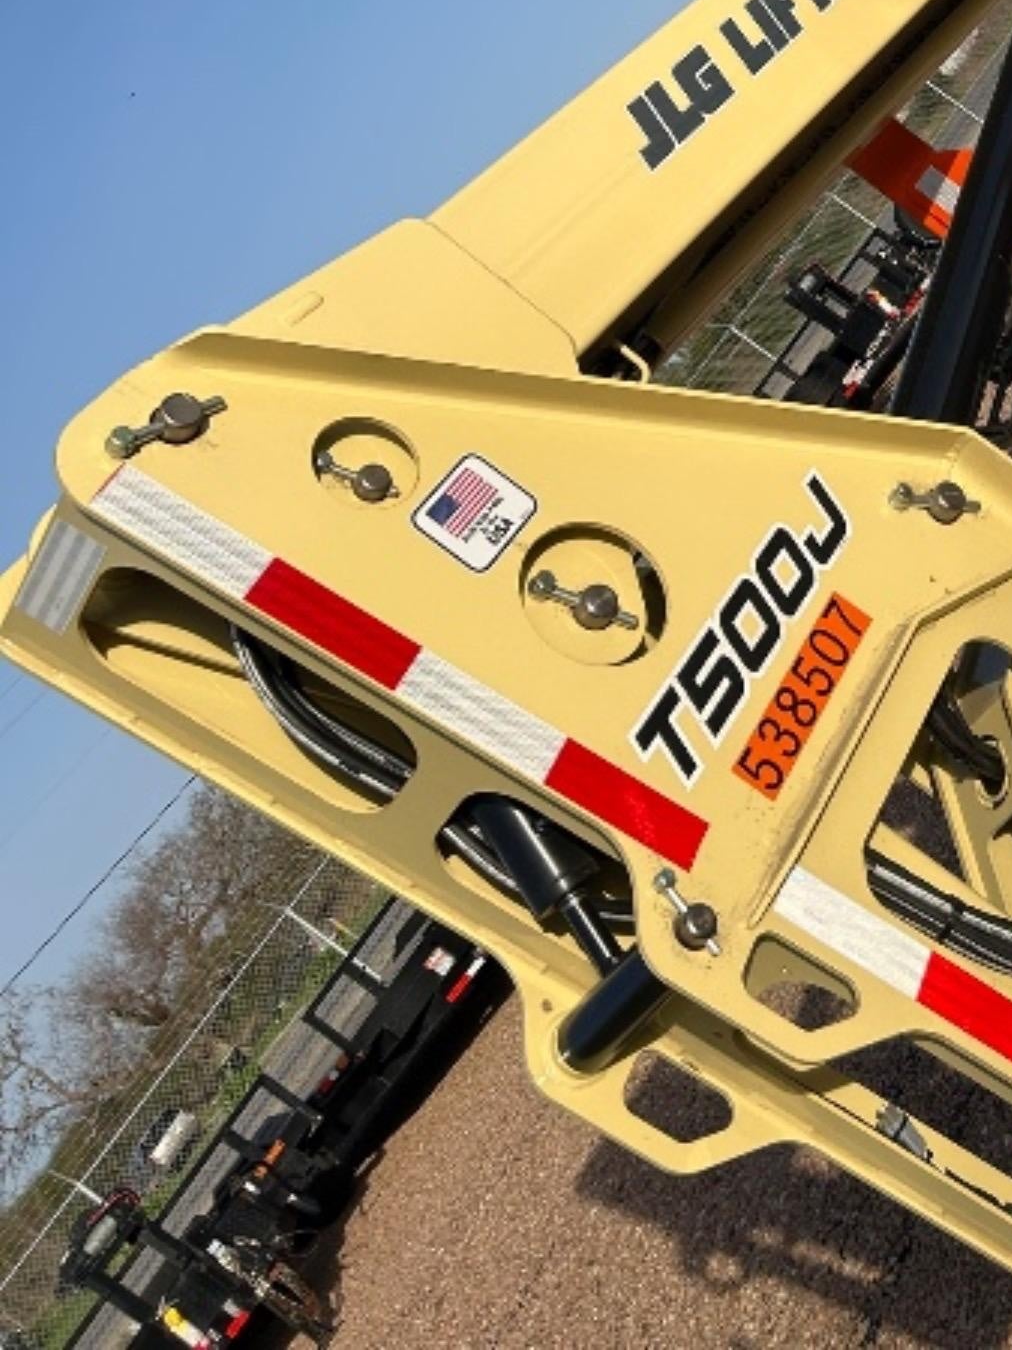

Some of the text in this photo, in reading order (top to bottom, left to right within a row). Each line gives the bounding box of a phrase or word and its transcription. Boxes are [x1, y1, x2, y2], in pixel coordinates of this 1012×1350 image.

[625, 44, 736, 171] JLG
[632, 472, 849, 785] T500J
[736, 597, 864, 790] 538507
